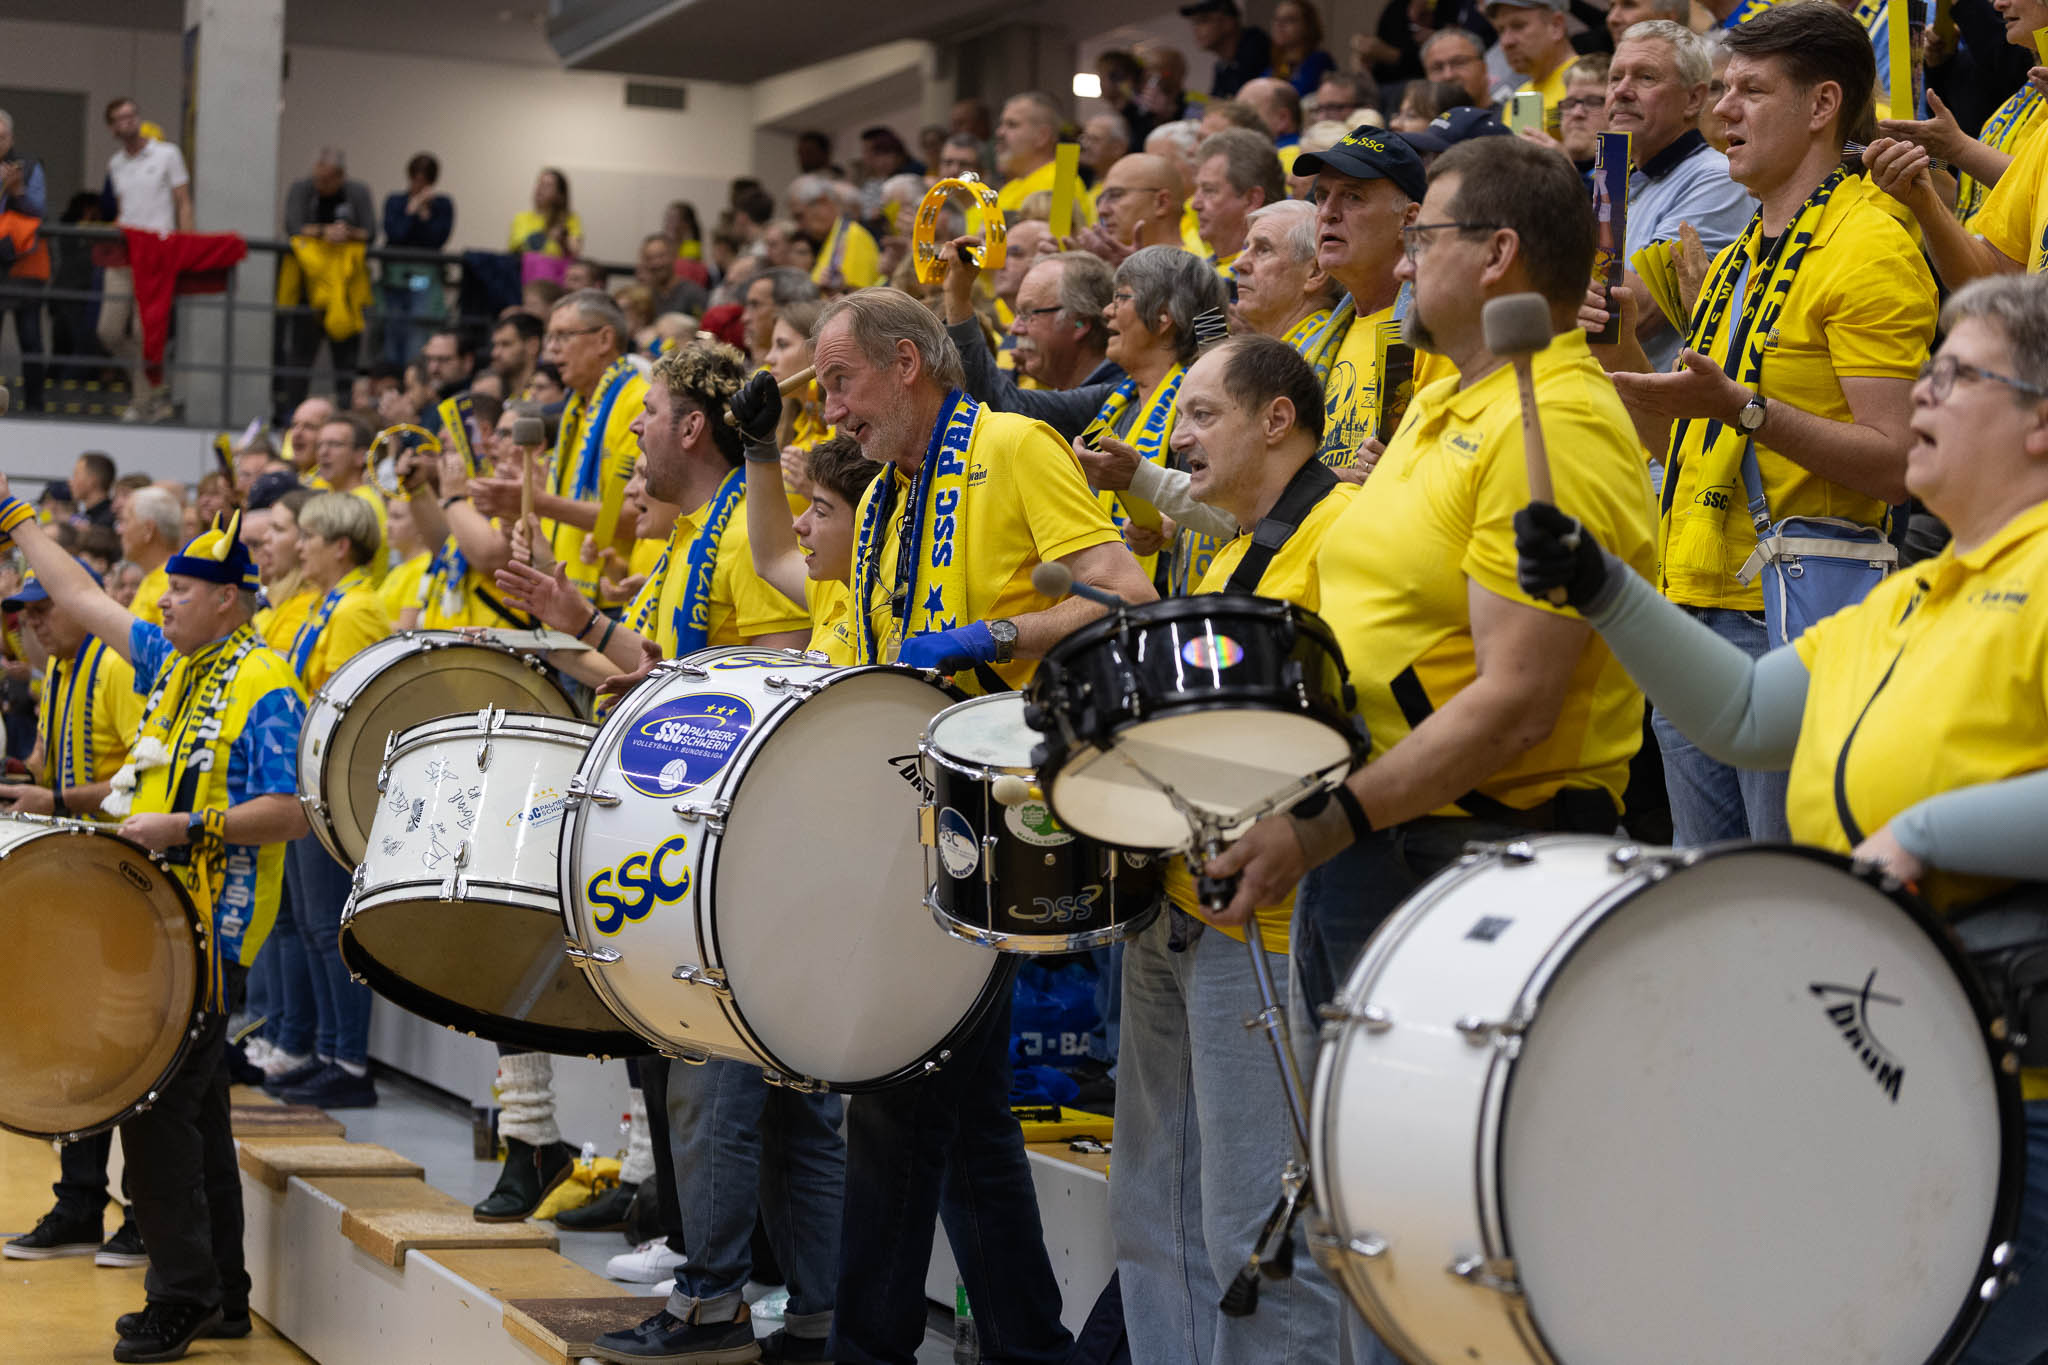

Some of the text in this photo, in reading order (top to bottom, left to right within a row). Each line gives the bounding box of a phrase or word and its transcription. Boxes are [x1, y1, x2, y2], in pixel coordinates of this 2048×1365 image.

[1358, 137, 1385, 152] SSC
[1742, 258, 1776, 320] SSC
[1703, 491, 1728, 511] SSC
[932, 486, 962, 568] SSC
[654, 721, 690, 744] SSC
[681, 735, 731, 751] SCHWERIN
[687, 726, 738, 742] PALMBERG
[632, 739, 673, 751] VOLLEYBALL
[680, 746, 724, 760] BUNDESLIGA
[585, 835, 692, 936] SSC
[1033, 893, 1093, 924] SSC
